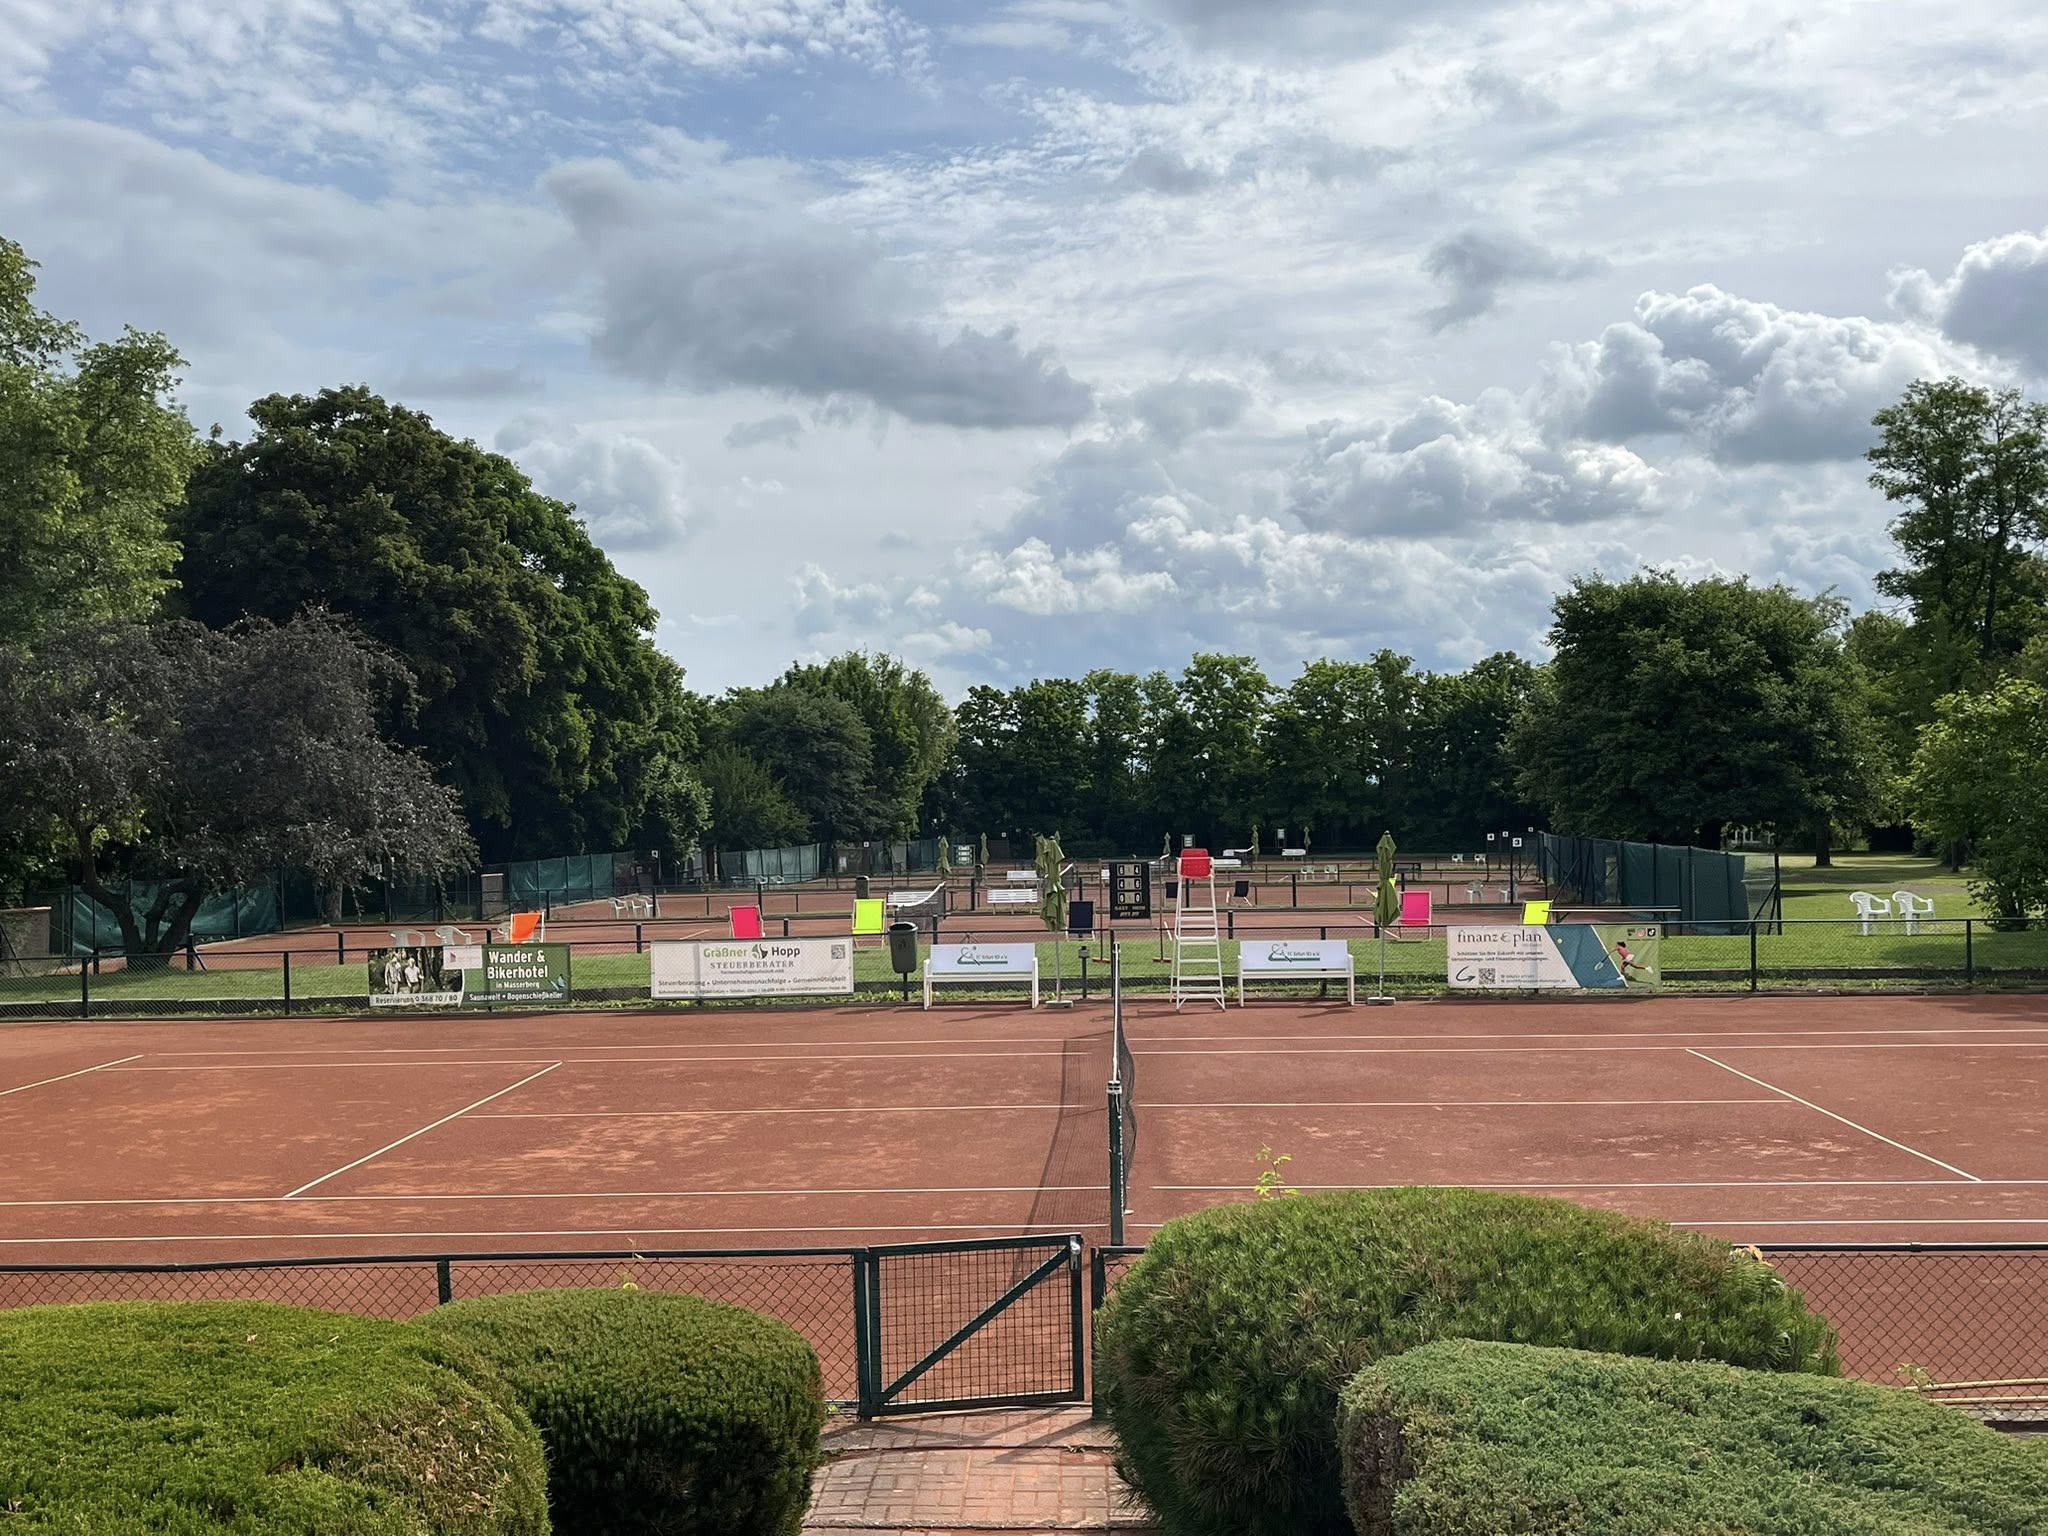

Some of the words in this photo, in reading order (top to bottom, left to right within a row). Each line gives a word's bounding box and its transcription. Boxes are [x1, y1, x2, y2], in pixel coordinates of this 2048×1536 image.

[1457, 930, 1498, 943] finanz
[1513, 929, 1542, 947] plan
[488, 950, 533, 964] Wander
[536, 949, 546, 963] &
[703, 947, 748, 958] Gräßner
[771, 946, 801, 958] Hopp
[710, 960, 795, 969] STEUERBERATER
[487, 965, 549, 980] Bikerhotel
[503, 980, 540, 989] Masserberg
[711, 977, 787, 986] Unternehmensnachfolge
[792, 976, 847, 984] Gemeinnützigkeit
[469, 993, 501, 1001] Saunawelt
